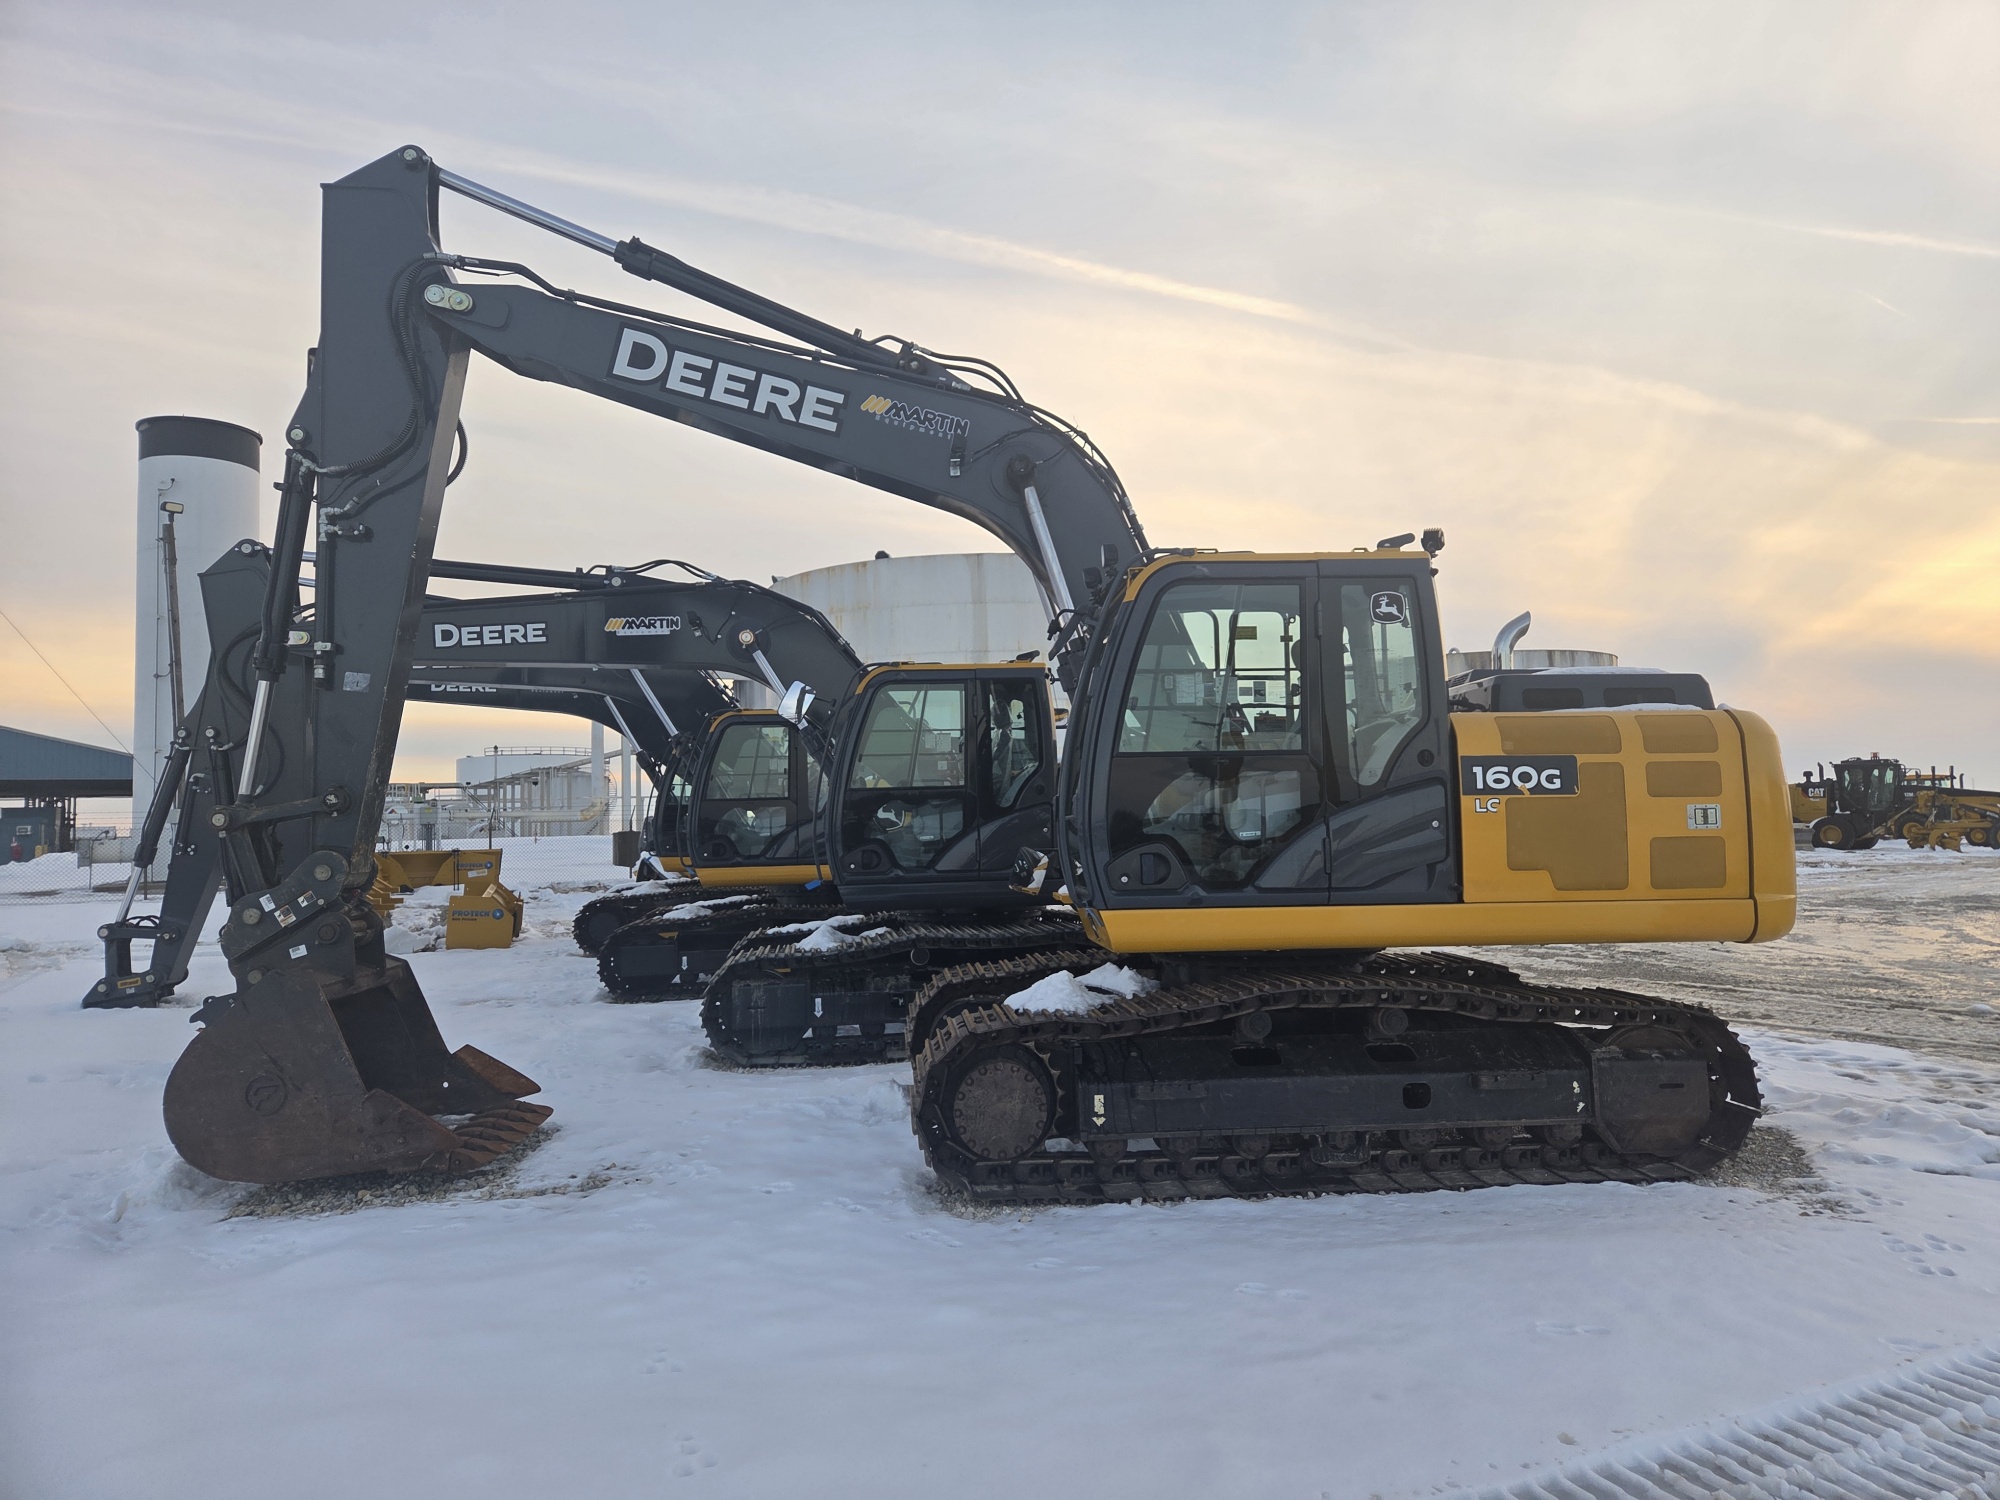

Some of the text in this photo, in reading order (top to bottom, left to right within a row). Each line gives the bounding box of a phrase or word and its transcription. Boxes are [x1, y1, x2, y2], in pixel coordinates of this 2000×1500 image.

[612, 327, 845, 432] DEERE
[882, 400, 970, 437] MARTIN
[434, 623, 547, 648] DEERE
[621, 616, 680, 630] MARTIN
[1472, 765, 1561, 790] 160G
[1808, 787, 1825, 797] CAT
[1475, 797, 1500, 813] LC
